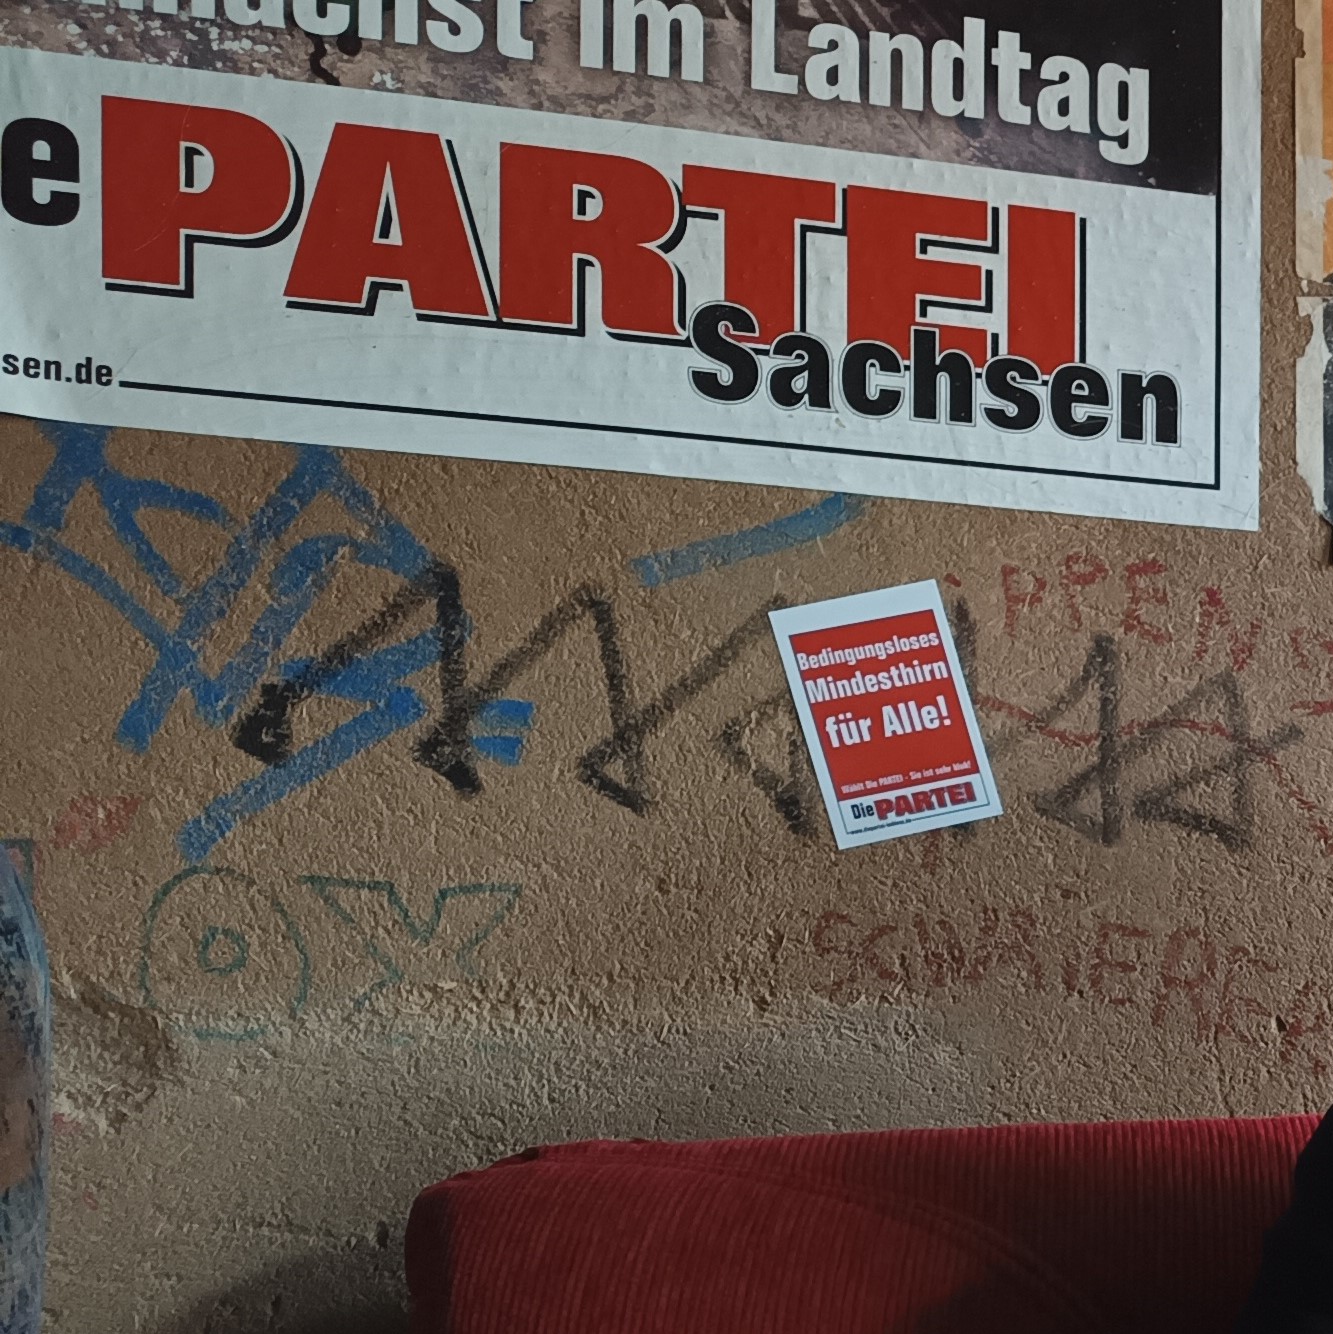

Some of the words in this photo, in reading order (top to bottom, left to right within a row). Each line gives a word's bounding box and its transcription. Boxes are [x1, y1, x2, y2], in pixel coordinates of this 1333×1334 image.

[578, 0, 704, 83] im
[751, 0, 1150, 165] Landtag
[101, 95, 1087, 385] PARTEI
[687, 299, 1182, 448] Sachsen
[796, 631, 940, 671] Bedingungsloses
[804, 660, 949, 704] Mindesthirn
[825, 712, 872, 748] für
[881, 694, 951, 738] Alle!
[851, 801, 875, 820] Die
[874, 781, 978, 821] PARTEI
[878, 773, 904, 787] PARTEI
[909, 770, 922, 781] Sie
